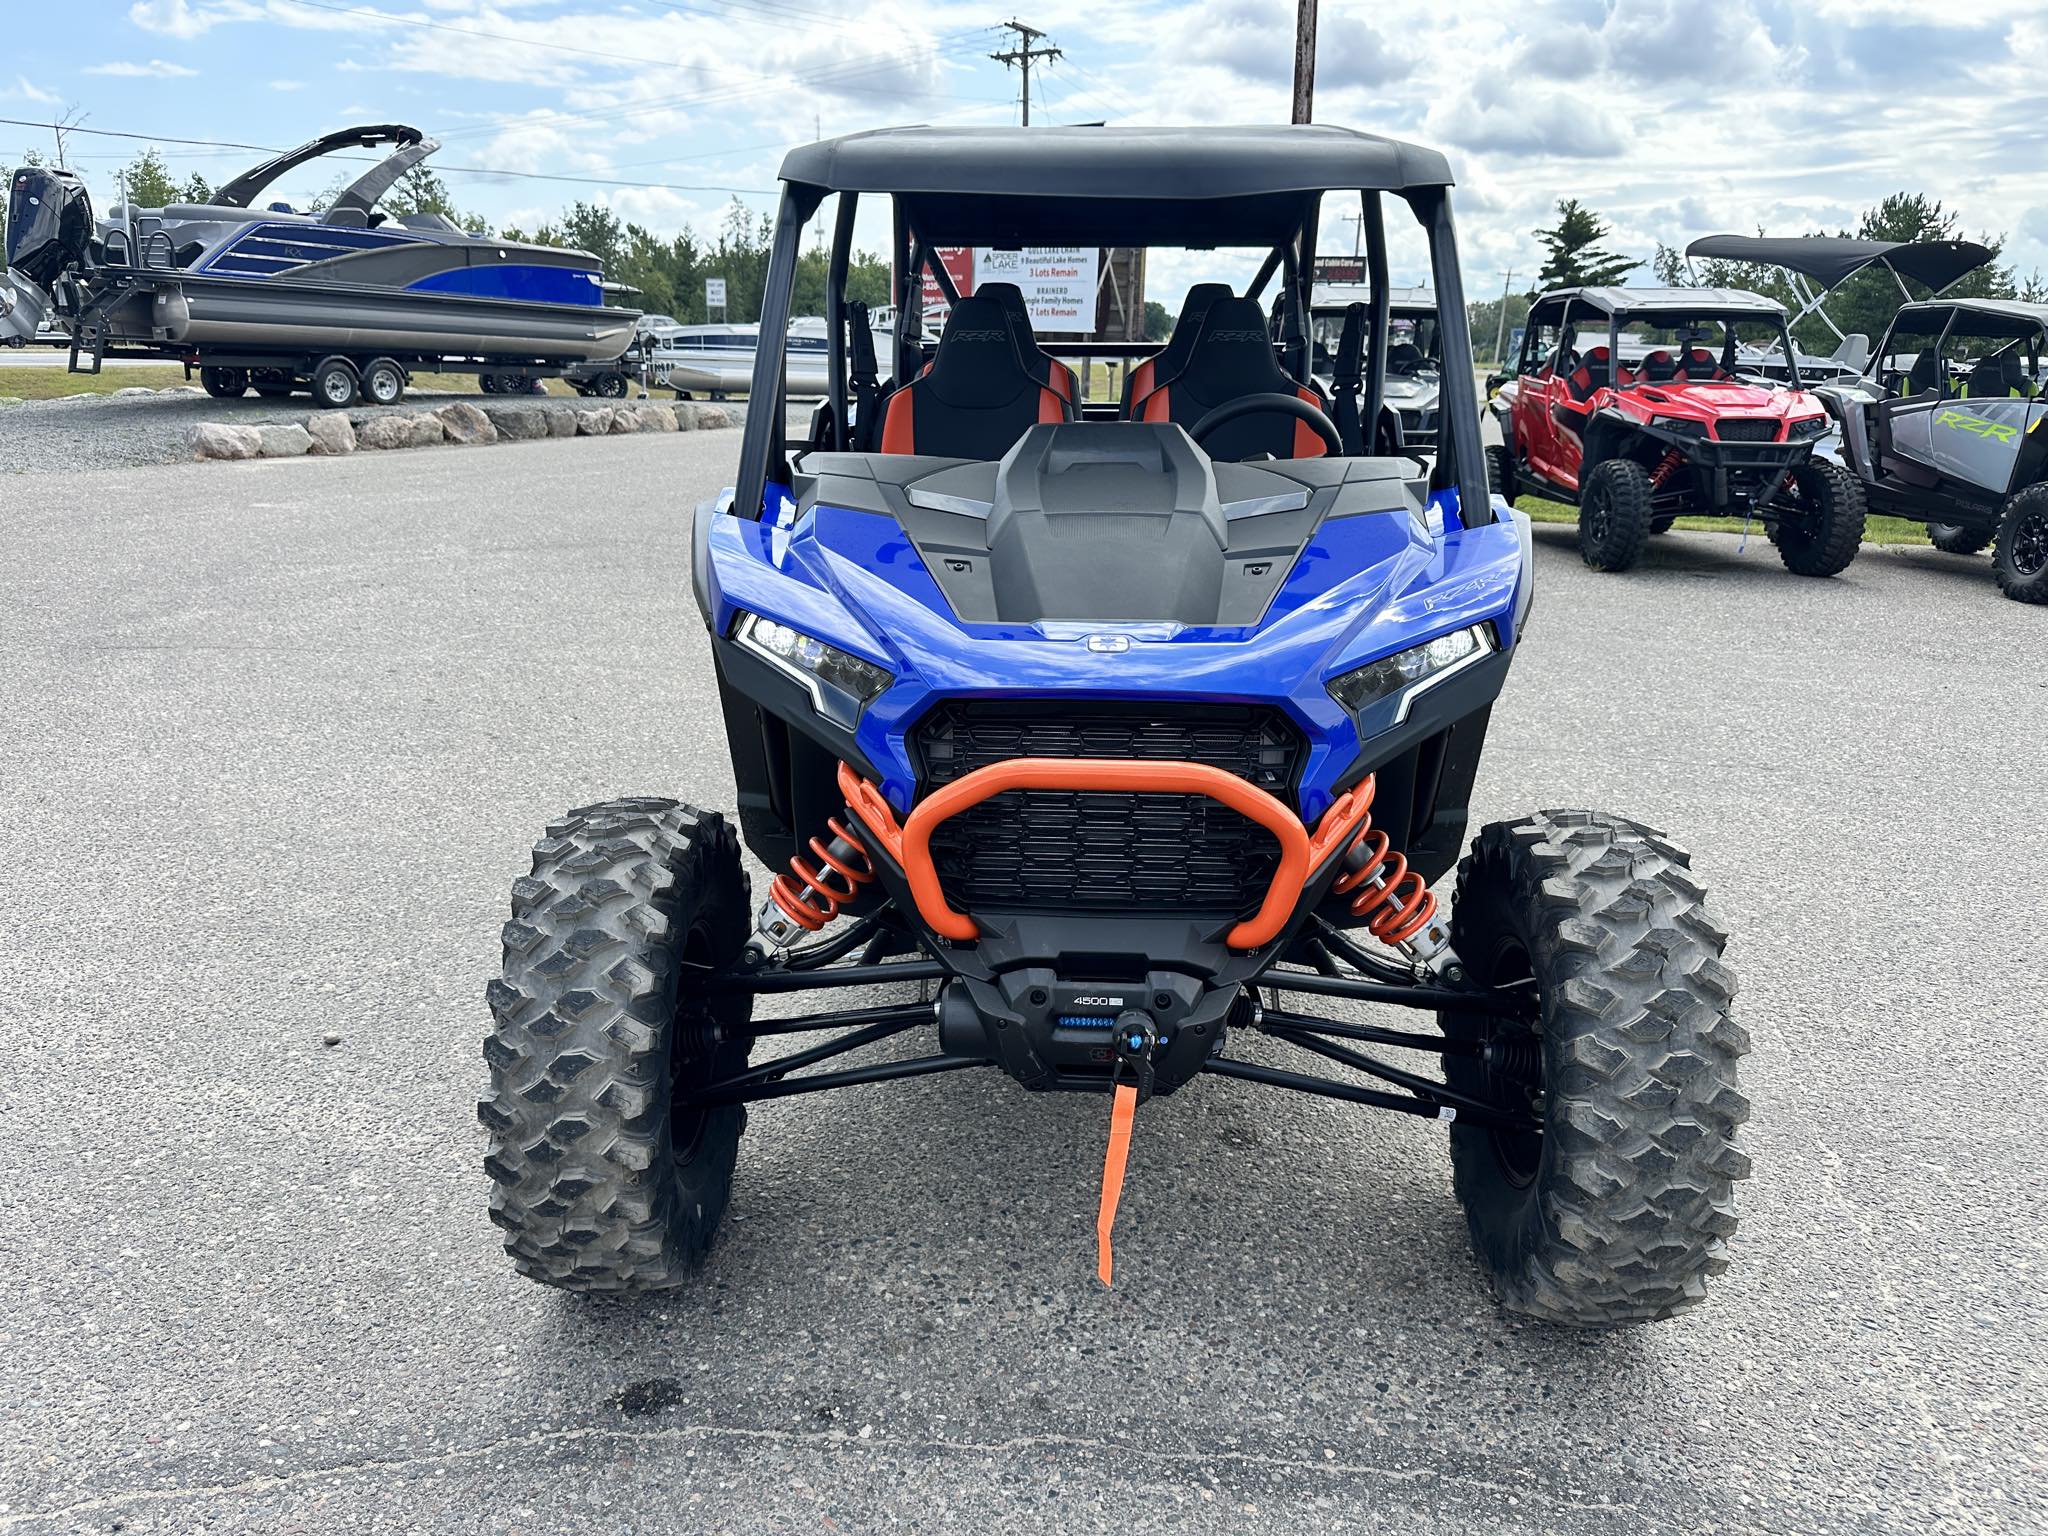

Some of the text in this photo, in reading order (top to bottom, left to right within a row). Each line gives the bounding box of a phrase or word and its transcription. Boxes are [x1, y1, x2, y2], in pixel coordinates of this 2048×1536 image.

[992, 261, 1018, 269] LAKE
[1035, 268, 1050, 277] Lots
[1051, 267, 1078, 277] Remain
[1037, 287, 1068, 295] BRAINERD
[1041, 297, 1061, 305] Family
[1063, 297, 1083, 305] Homes
[1036, 308, 1050, 316] Lots
[1051, 307, 1078, 316] Remain
[951, 330, 1005, 342] RZR
[1208, 330, 1264, 342] RZR
[1935, 410, 2018, 444] RZR
[1074, 997, 1108, 1006] 4500
